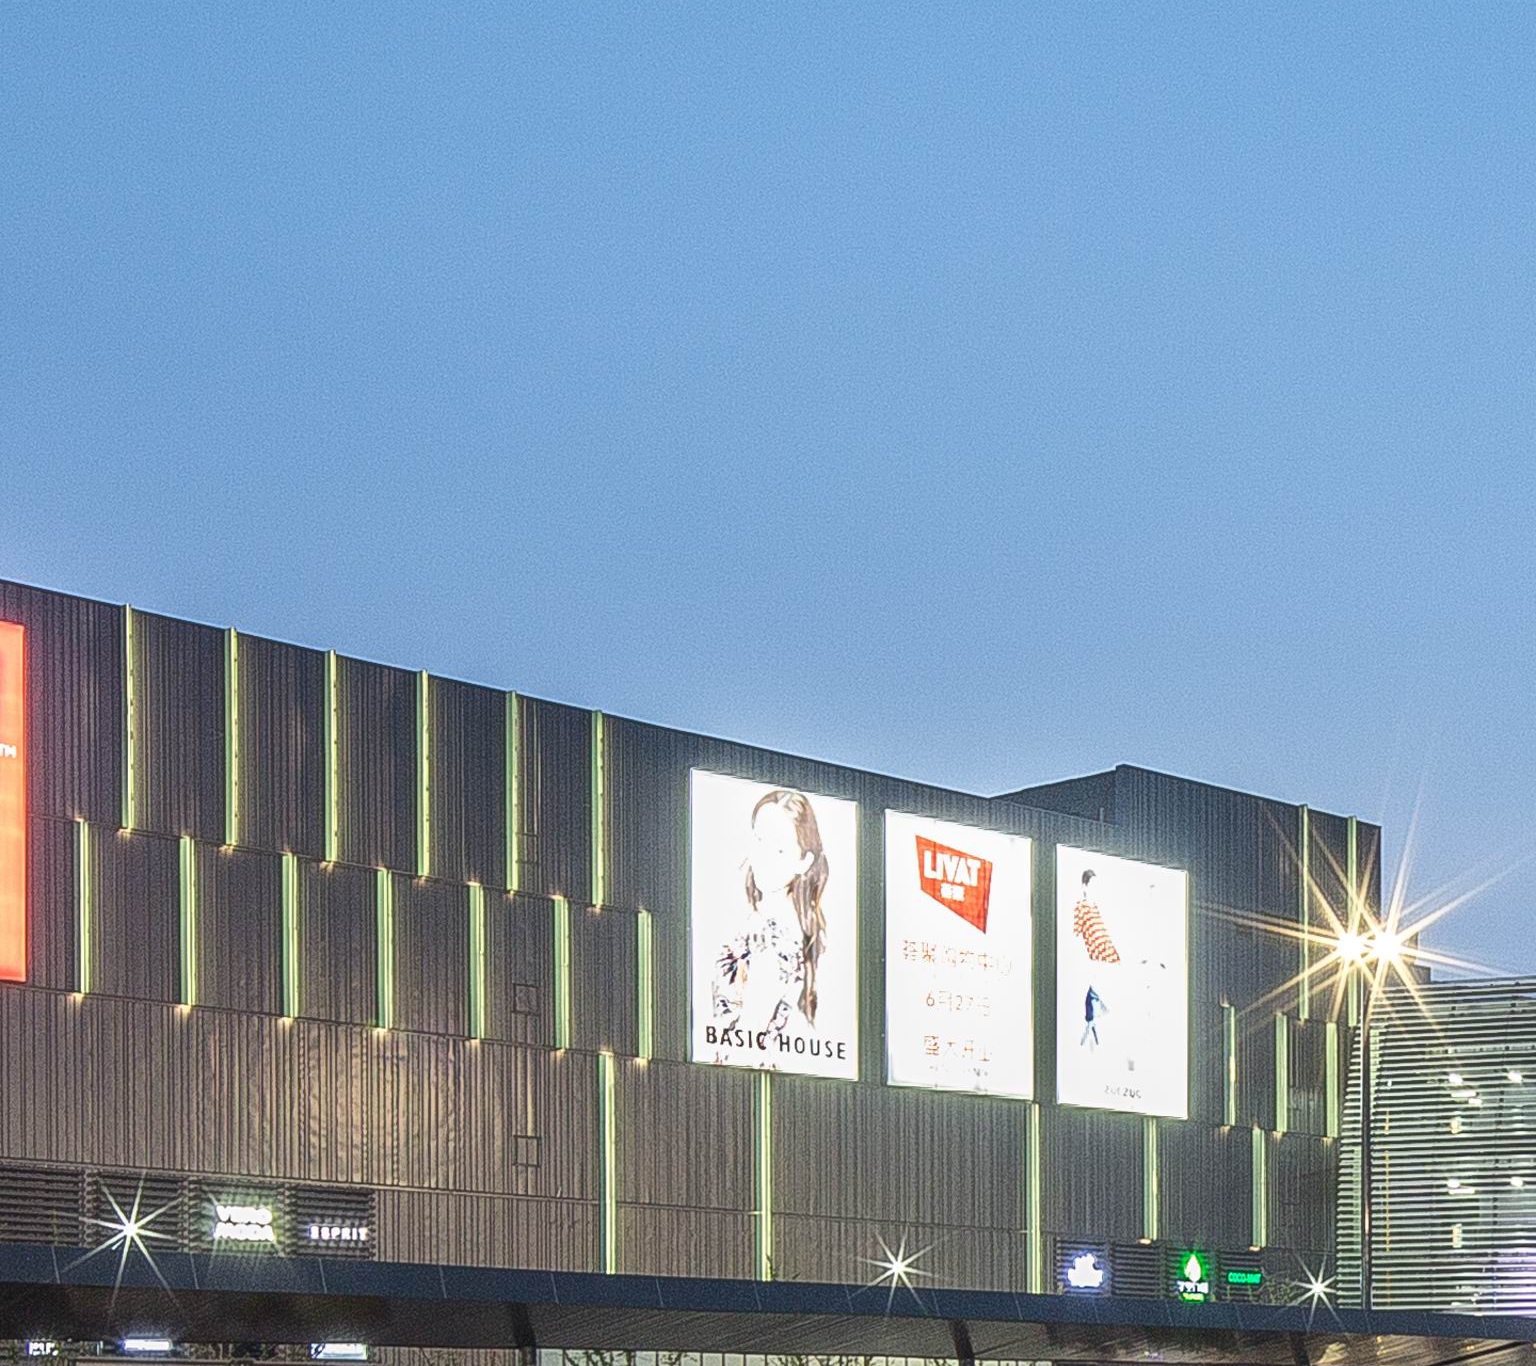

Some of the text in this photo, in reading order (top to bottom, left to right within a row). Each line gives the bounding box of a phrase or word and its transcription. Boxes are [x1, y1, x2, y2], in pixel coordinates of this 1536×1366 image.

[923, 849, 981, 887] LIVAT
[705, 1025, 846, 1060] BASIC HOUSE
